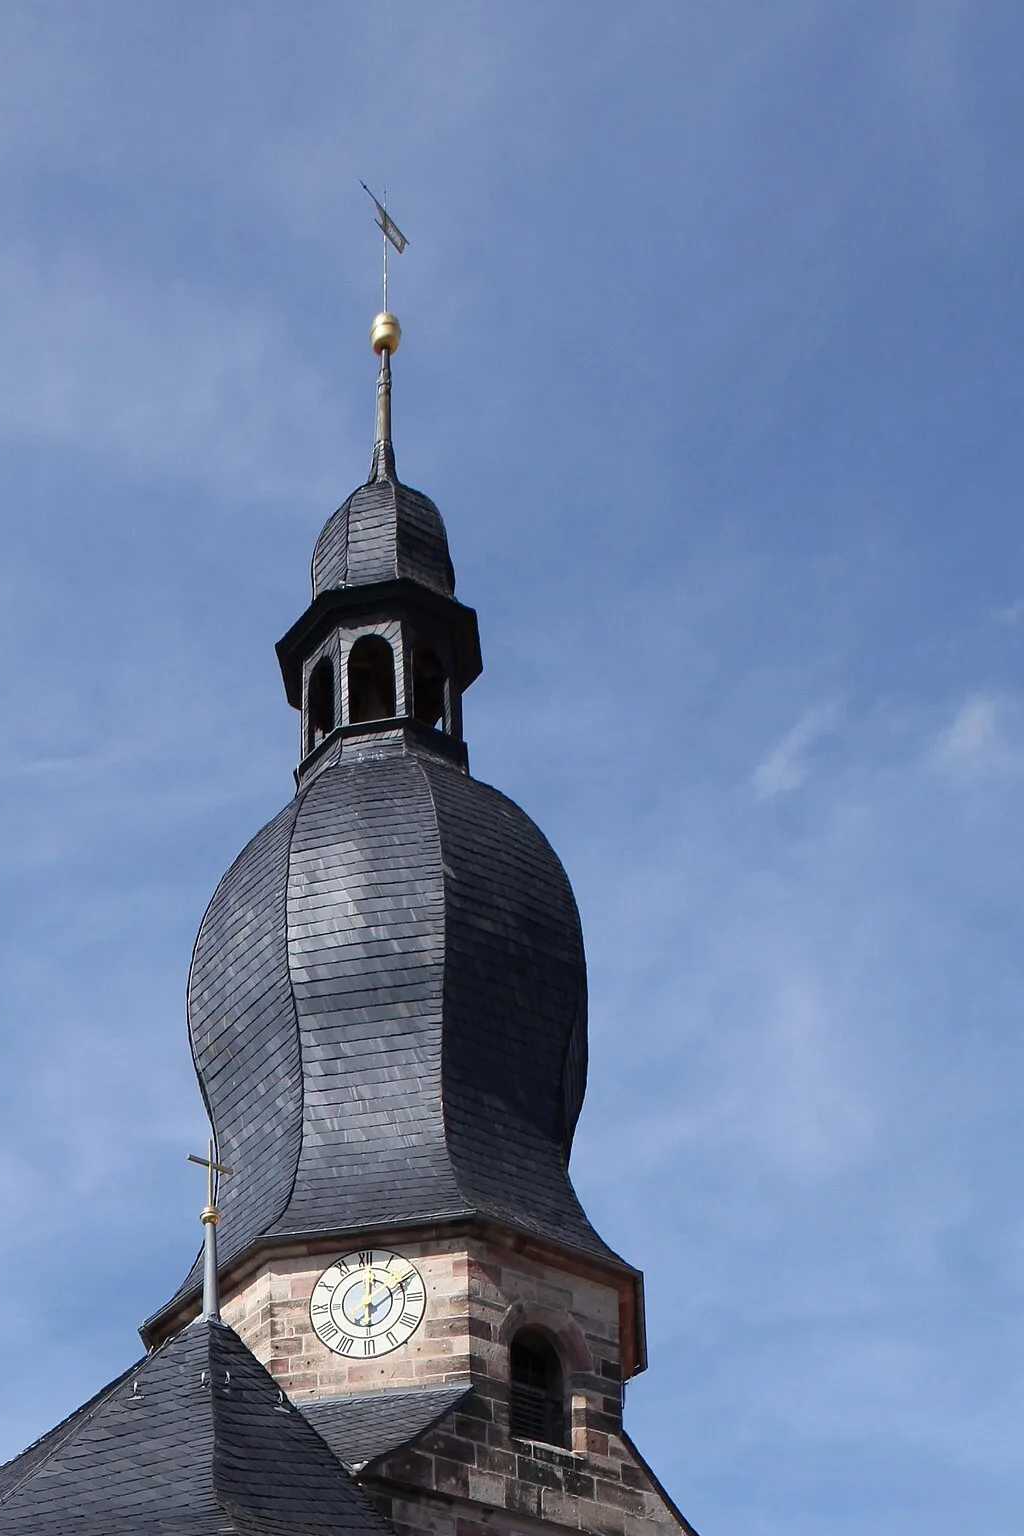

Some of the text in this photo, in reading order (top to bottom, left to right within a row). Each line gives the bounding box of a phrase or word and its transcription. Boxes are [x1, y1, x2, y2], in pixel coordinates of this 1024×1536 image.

[358, 1251, 373, 1267] XII
[334, 1260, 351, 1277] XI
[318, 1280, 334, 1292] X
[406, 1291, 423, 1303] III
[312, 1303, 329, 1316] IX
[316, 1320, 339, 1342] VIII
[335, 1335, 355, 1354] VII
[363, 1339, 376, 1356] VI
